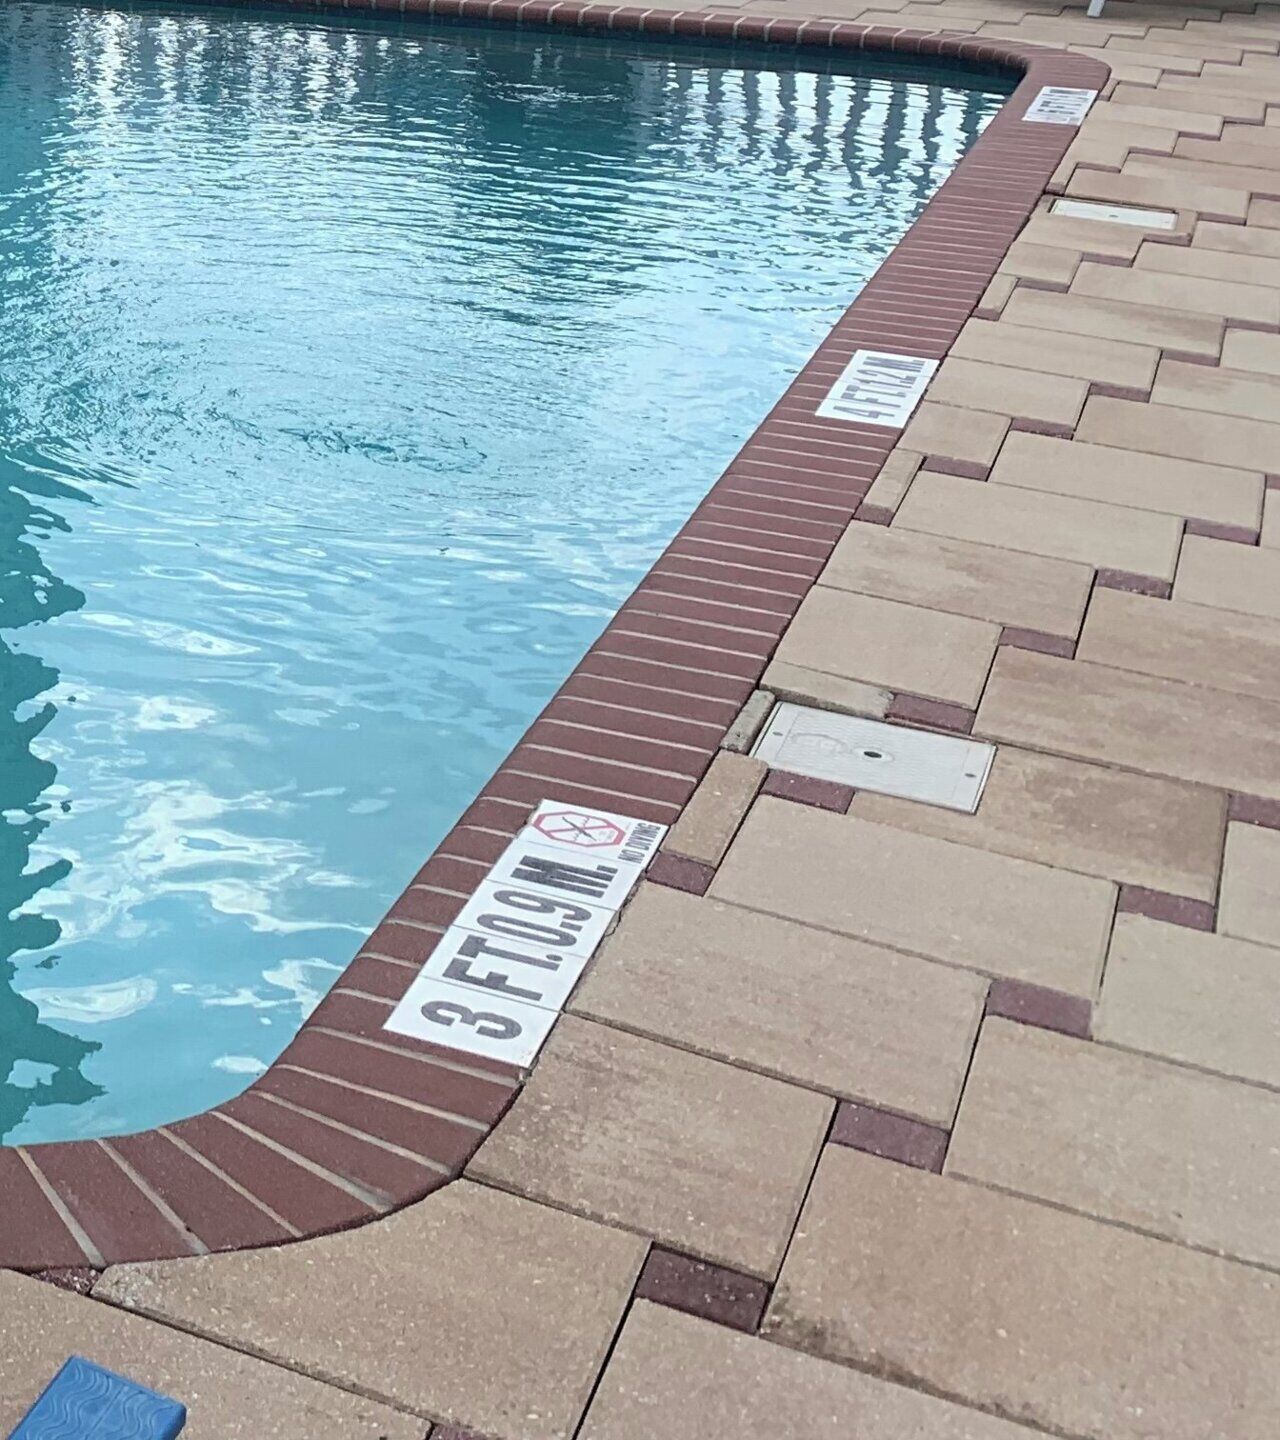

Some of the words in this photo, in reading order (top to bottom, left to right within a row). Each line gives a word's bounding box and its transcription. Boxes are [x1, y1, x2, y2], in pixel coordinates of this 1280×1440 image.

[624, 822, 661, 851] DIVING
[617, 849, 646, 864] NO
[421, 1000, 522, 1040] 3
